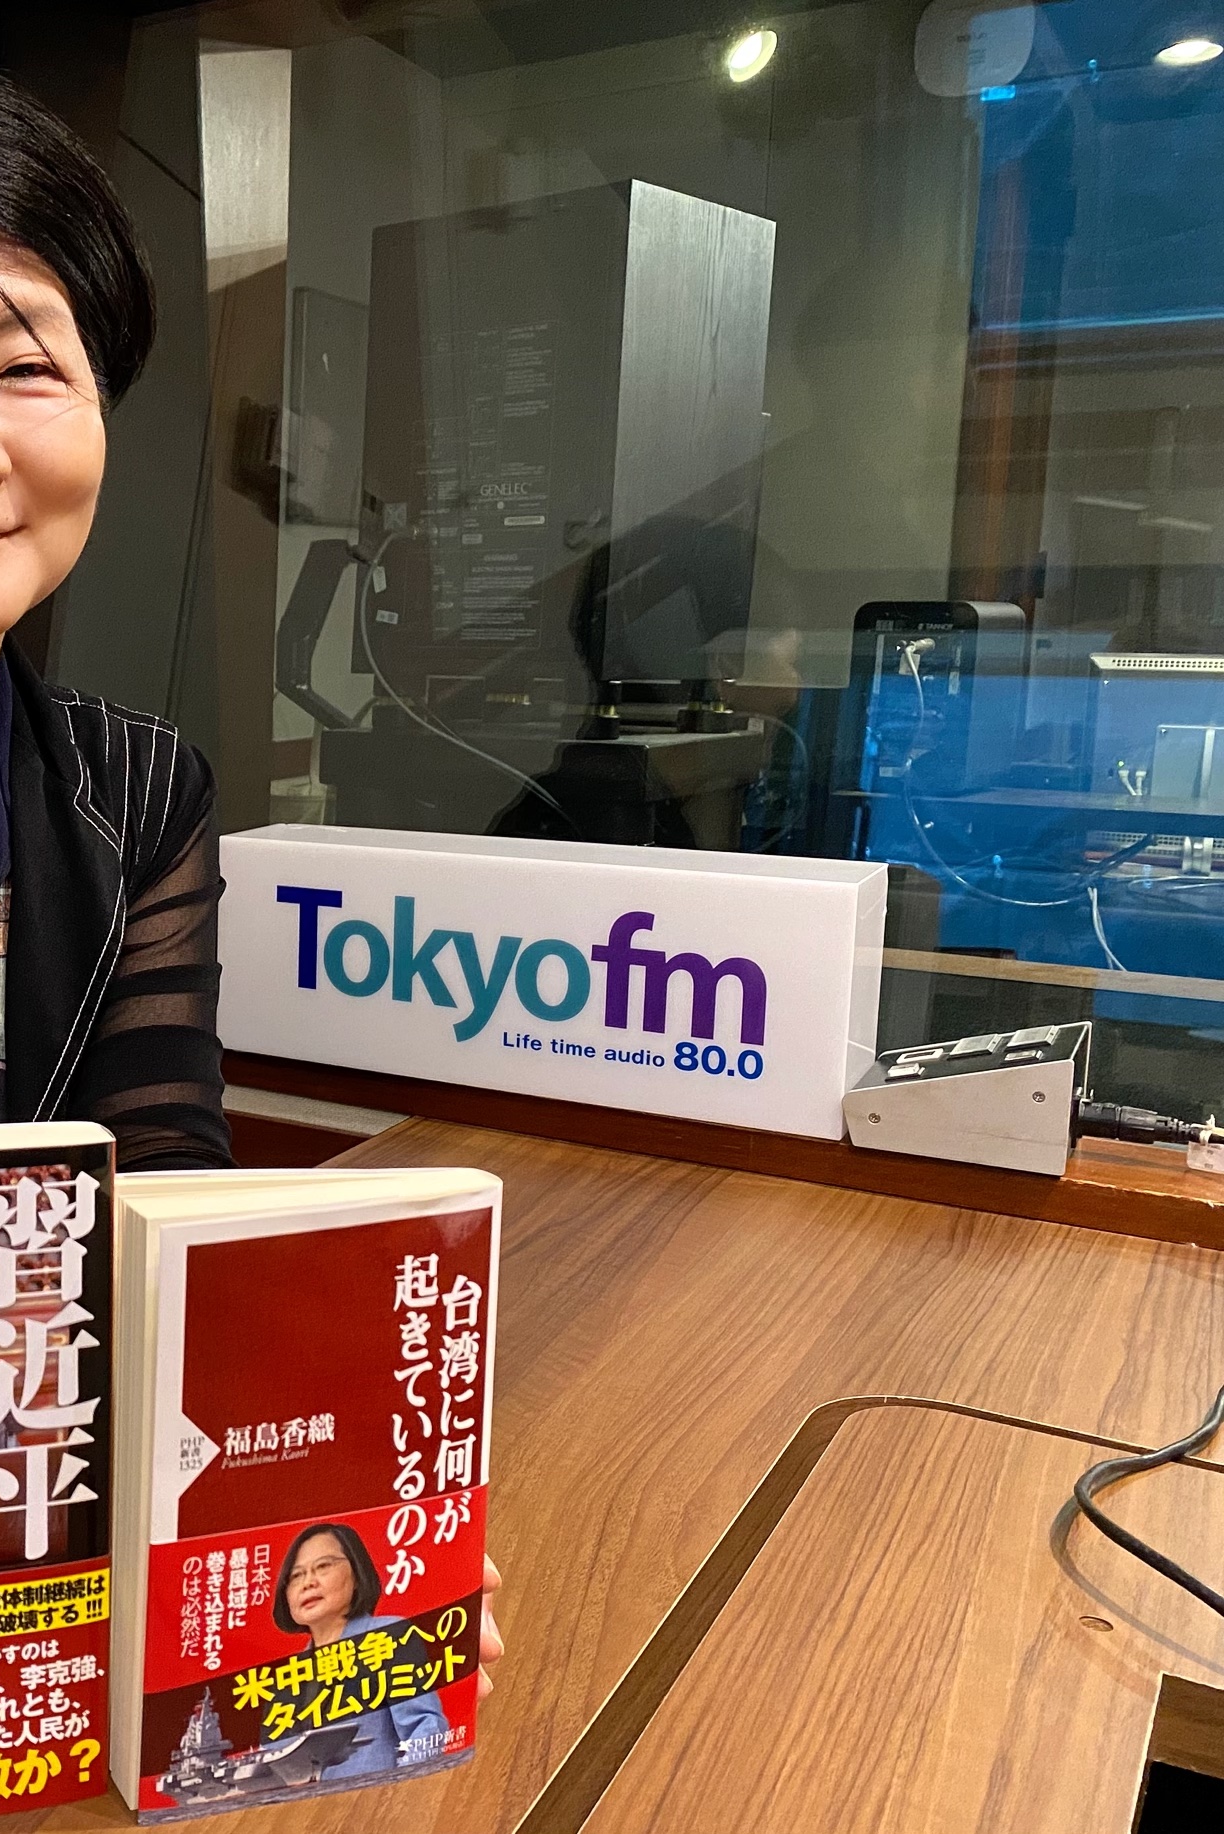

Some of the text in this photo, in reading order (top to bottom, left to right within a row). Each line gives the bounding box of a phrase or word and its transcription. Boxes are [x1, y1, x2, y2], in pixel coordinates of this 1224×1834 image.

[502, 1031, 764, 1080] Life time audio 80.0
[180, 1436, 206, 1449] PHP
[223, 1412, 336, 1456] 福島香織
[385, 1252, 440, 1596] 起きているのか
[432, 1274, 482, 1546] 台湾に何が
[180, 1556, 203, 1658] のは必然だ
[202, 1551, 226, 1671] 巻き込まれる
[227, 1546, 249, 1630] 暴風域に
[250, 1544, 271, 1606] 日本が
[232, 1606, 468, 1711] 米中戦争への
[263, 1646, 466, 1740] タイムリミット
[413, 1725, 467, 1752] PHP新書
